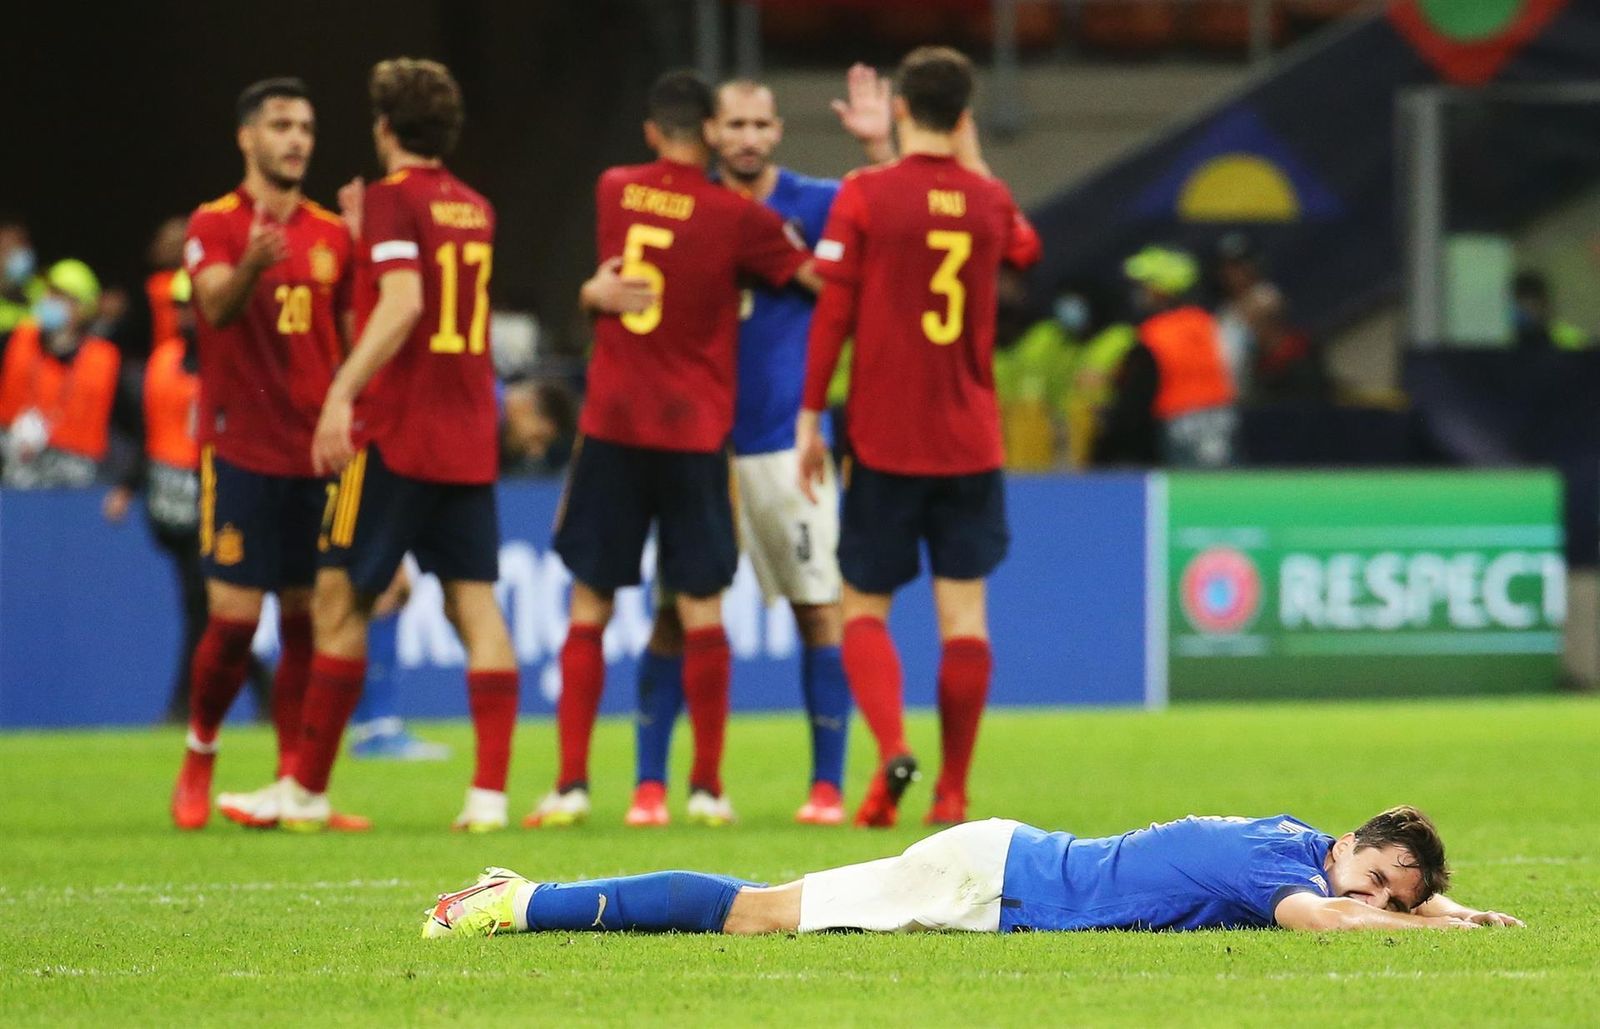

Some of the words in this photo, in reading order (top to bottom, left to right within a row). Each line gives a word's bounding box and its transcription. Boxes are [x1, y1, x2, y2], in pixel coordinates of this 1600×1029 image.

[274, 284, 313, 333] 20
[429, 242, 493, 355] 17
[621, 223, 674, 335] 5
[921, 230, 972, 345] 3
